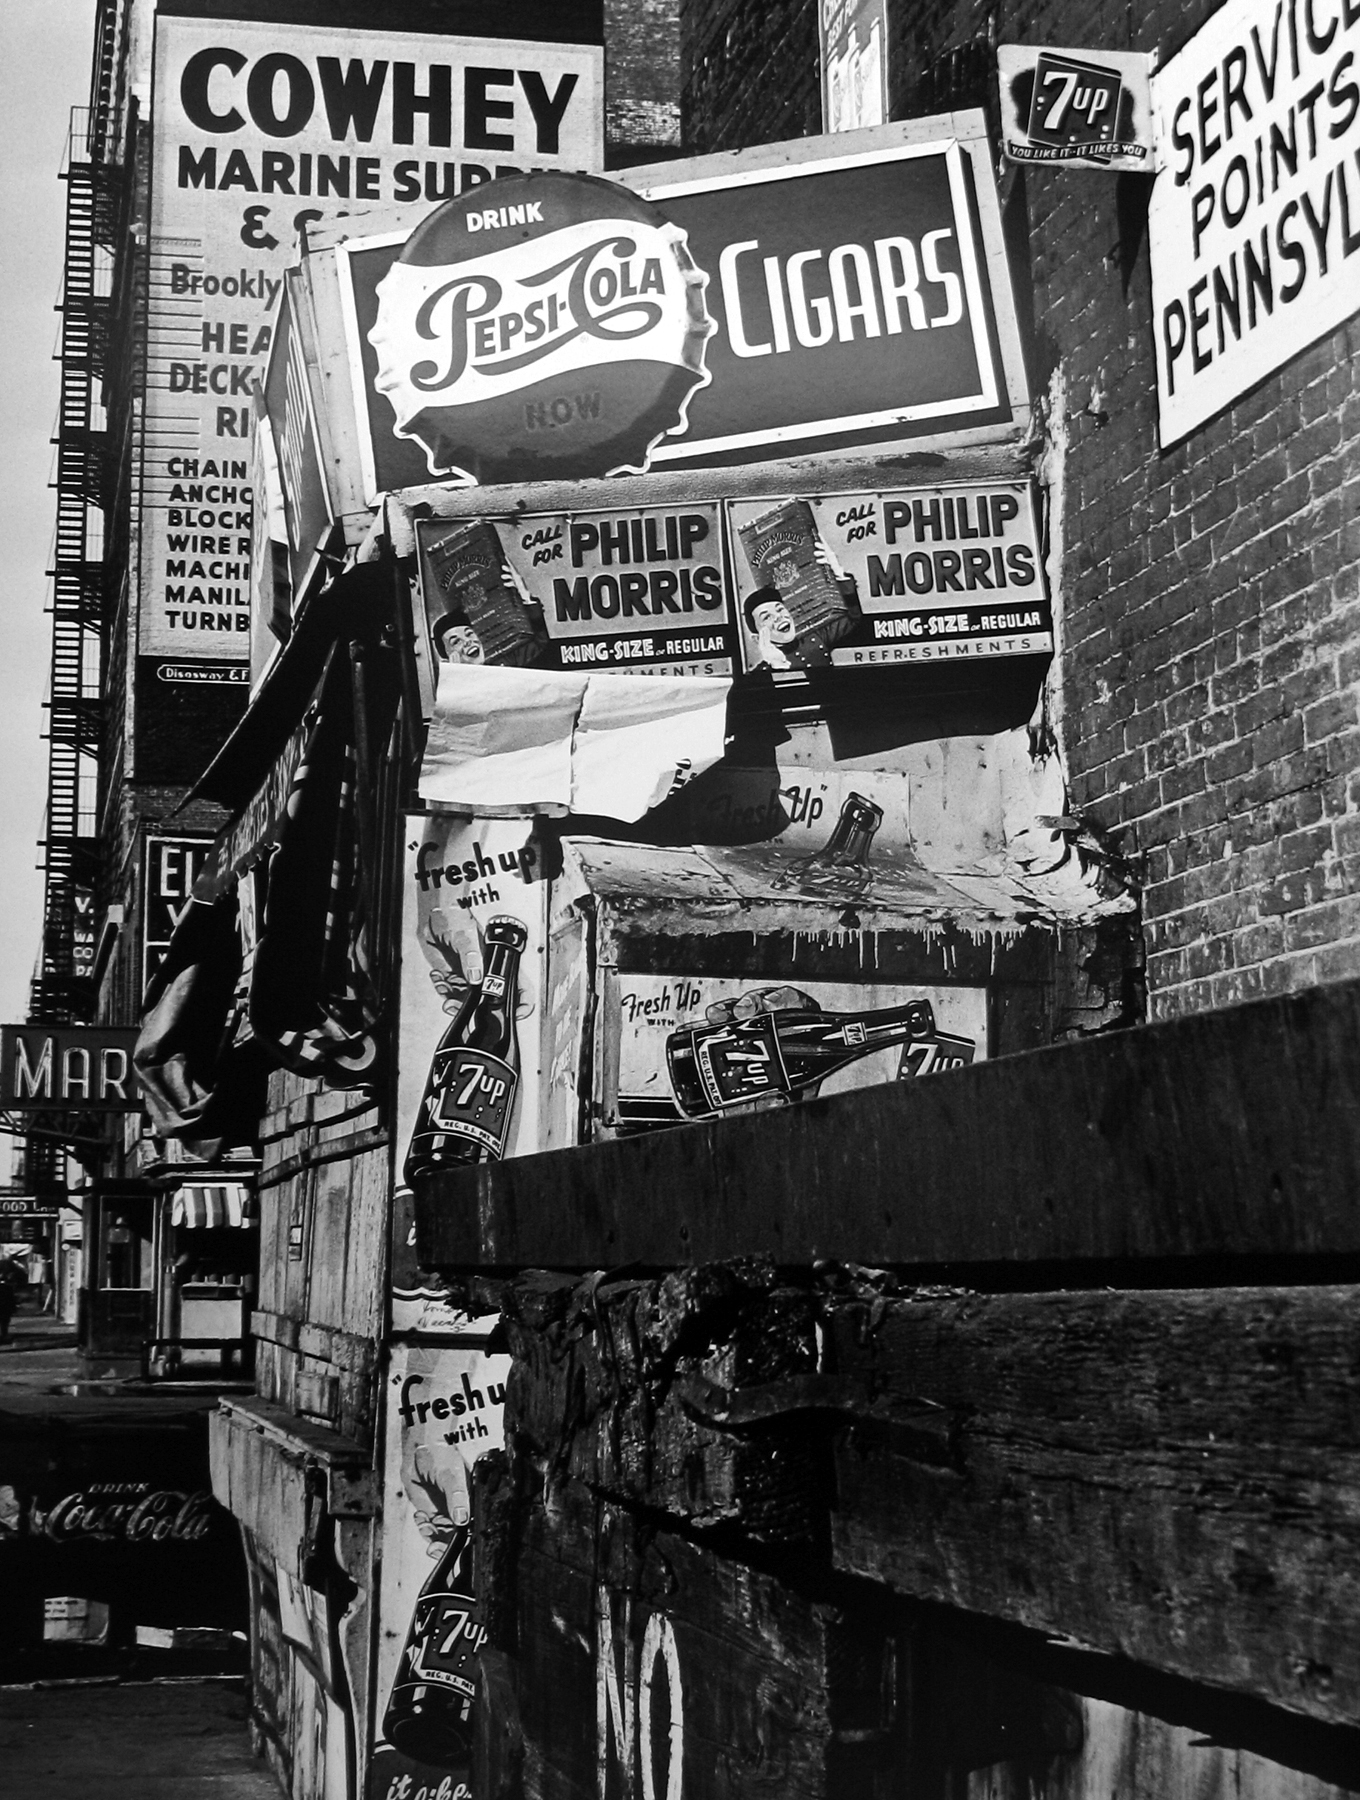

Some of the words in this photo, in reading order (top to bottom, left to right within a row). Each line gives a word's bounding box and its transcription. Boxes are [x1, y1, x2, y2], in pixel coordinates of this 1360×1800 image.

[180, 46, 580, 154] COWHEY
[1172, 0, 1360, 187] SERVIC
[1011, 146, 1031, 158] YOU
[1033, 146, 1056, 158] LIKE
[1088, 142, 1119, 154] LIKES
[1121, 144, 1143, 156] YOU
[1191, 51, 1360, 260] POINTS
[178, 146, 381, 200] MARINE
[240, 205, 279, 250] &
[466, 202, 544, 232] DRINK
[1163, 148, 1360, 398] PENNSYL
[719, 228, 963, 358] CIGARS
[167, 457, 246, 479] CHAIN
[835, 502, 877, 527] CALL
[882, 493, 1019, 545] PHILIP
[846, 521, 877, 543] FOR
[167, 534, 230, 555] WIRE
[521, 525, 563, 551] CALL
[569, 513, 710, 568] PHILIP
[533, 543, 564, 567] FOR
[866, 544, 1037, 598] MORRIS
[553, 566, 723, 622] MORRIS
[873, 614, 970, 639] KING-SIZE
[981, 611, 1042, 631] REGULAR
[560, 638, 655, 664] KING-SIZE
[665, 636, 725, 656] REGULAR
[854, 638, 1032, 663] REFRESHMENTS
[498, 846, 537, 884] up
[456, 882, 500, 909] with
[14, 1037, 144, 1100] MAR
[443, 1416, 489, 1445] with
[88, 1482, 150, 1494] DRINK
